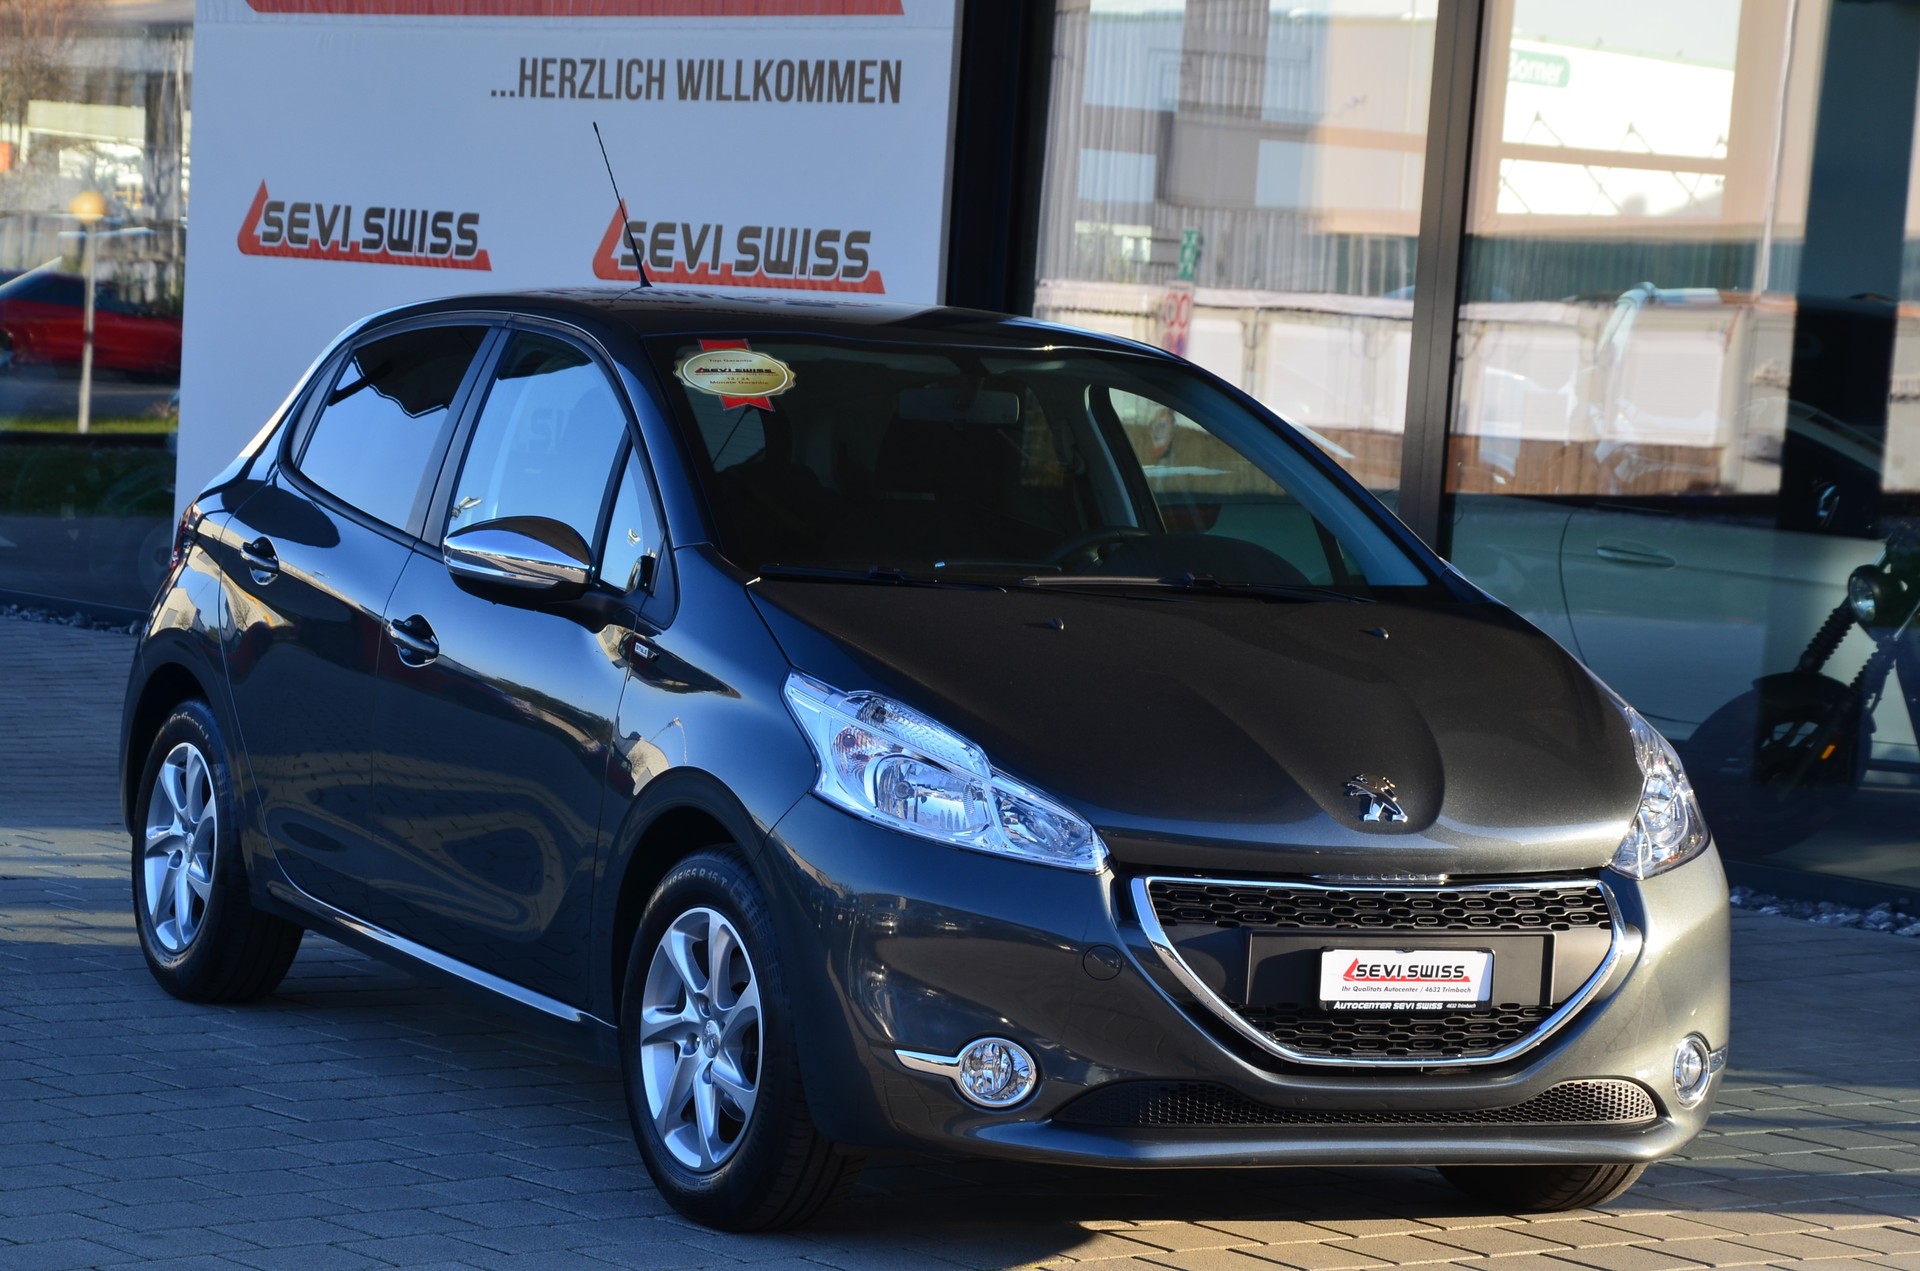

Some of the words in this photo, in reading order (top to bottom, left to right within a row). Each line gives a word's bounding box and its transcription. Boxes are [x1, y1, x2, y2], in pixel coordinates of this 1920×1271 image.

[676, 59, 902, 104] WILLKOMMEN
[261, 200, 351, 247] SEVI
[362, 206, 480, 257] SWISS
[620, 220, 721, 272] SEVI
[733, 226, 872, 279] SWISS
[1355, 964, 1401, 979] SEVI
[1406, 964, 1465, 979] SWISS
[1384, 985, 1418, 993] Autocenter
[1392, 1001, 1415, 1010] SEVI
[1415, 1001, 1443, 1010] SWISS
